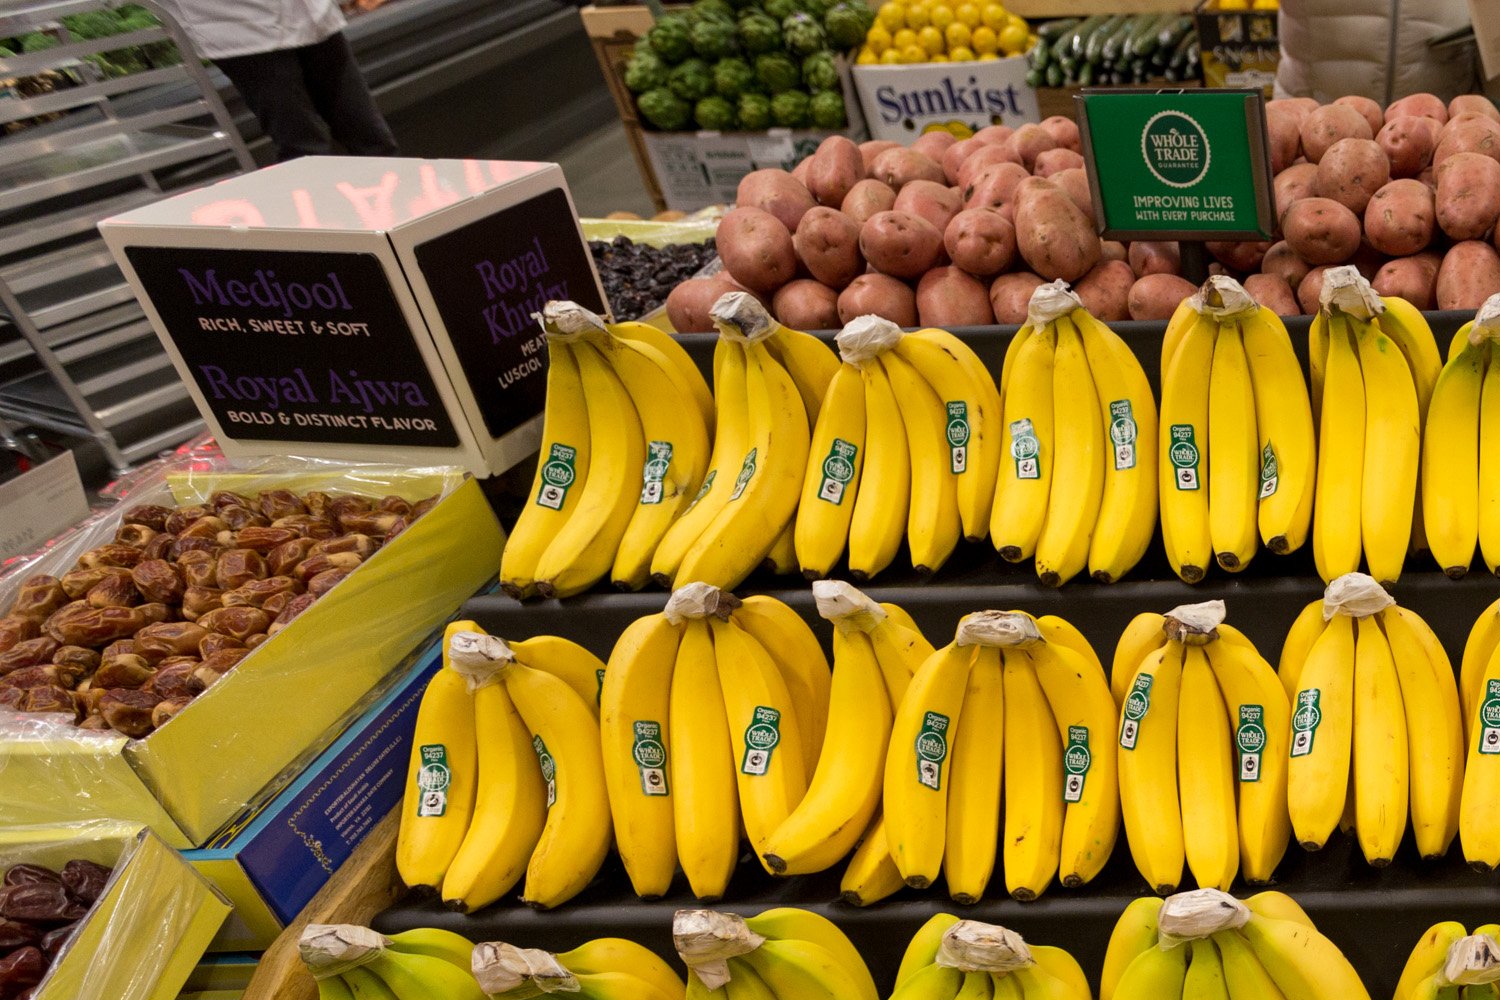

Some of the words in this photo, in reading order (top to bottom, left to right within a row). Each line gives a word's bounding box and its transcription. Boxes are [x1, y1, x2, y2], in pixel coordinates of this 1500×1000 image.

[876, 75, 1023, 125] Sunkist
[1150, 134, 1199, 148] WHOLE
[1154, 148, 1199, 161] TRADE
[1133, 195, 1199, 209] IMPROVING
[1203, 196, 1233, 209] LIVES
[1136, 210, 1159, 221] WITH
[1162, 211, 1187, 221] EVERY
[1191, 211, 1235, 221] PURCHASE
[474, 236, 550, 299] Royal
[178, 268, 353, 318] Medjool
[198, 317, 247, 333] RICH,
[249, 319, 305, 336] SWEET
[312, 321, 324, 335] &
[329, 321, 371, 337] SOFT
[498, 357, 542, 390] LUSCIO
[199, 365, 319, 410] Royal
[322, 368, 429, 414] Ajwa
[227, 410, 275, 426] BOLD
[280, 411, 291, 426] &
[297, 413, 367, 429] DISTINCT
[370, 416, 438, 432] FLAVOR
